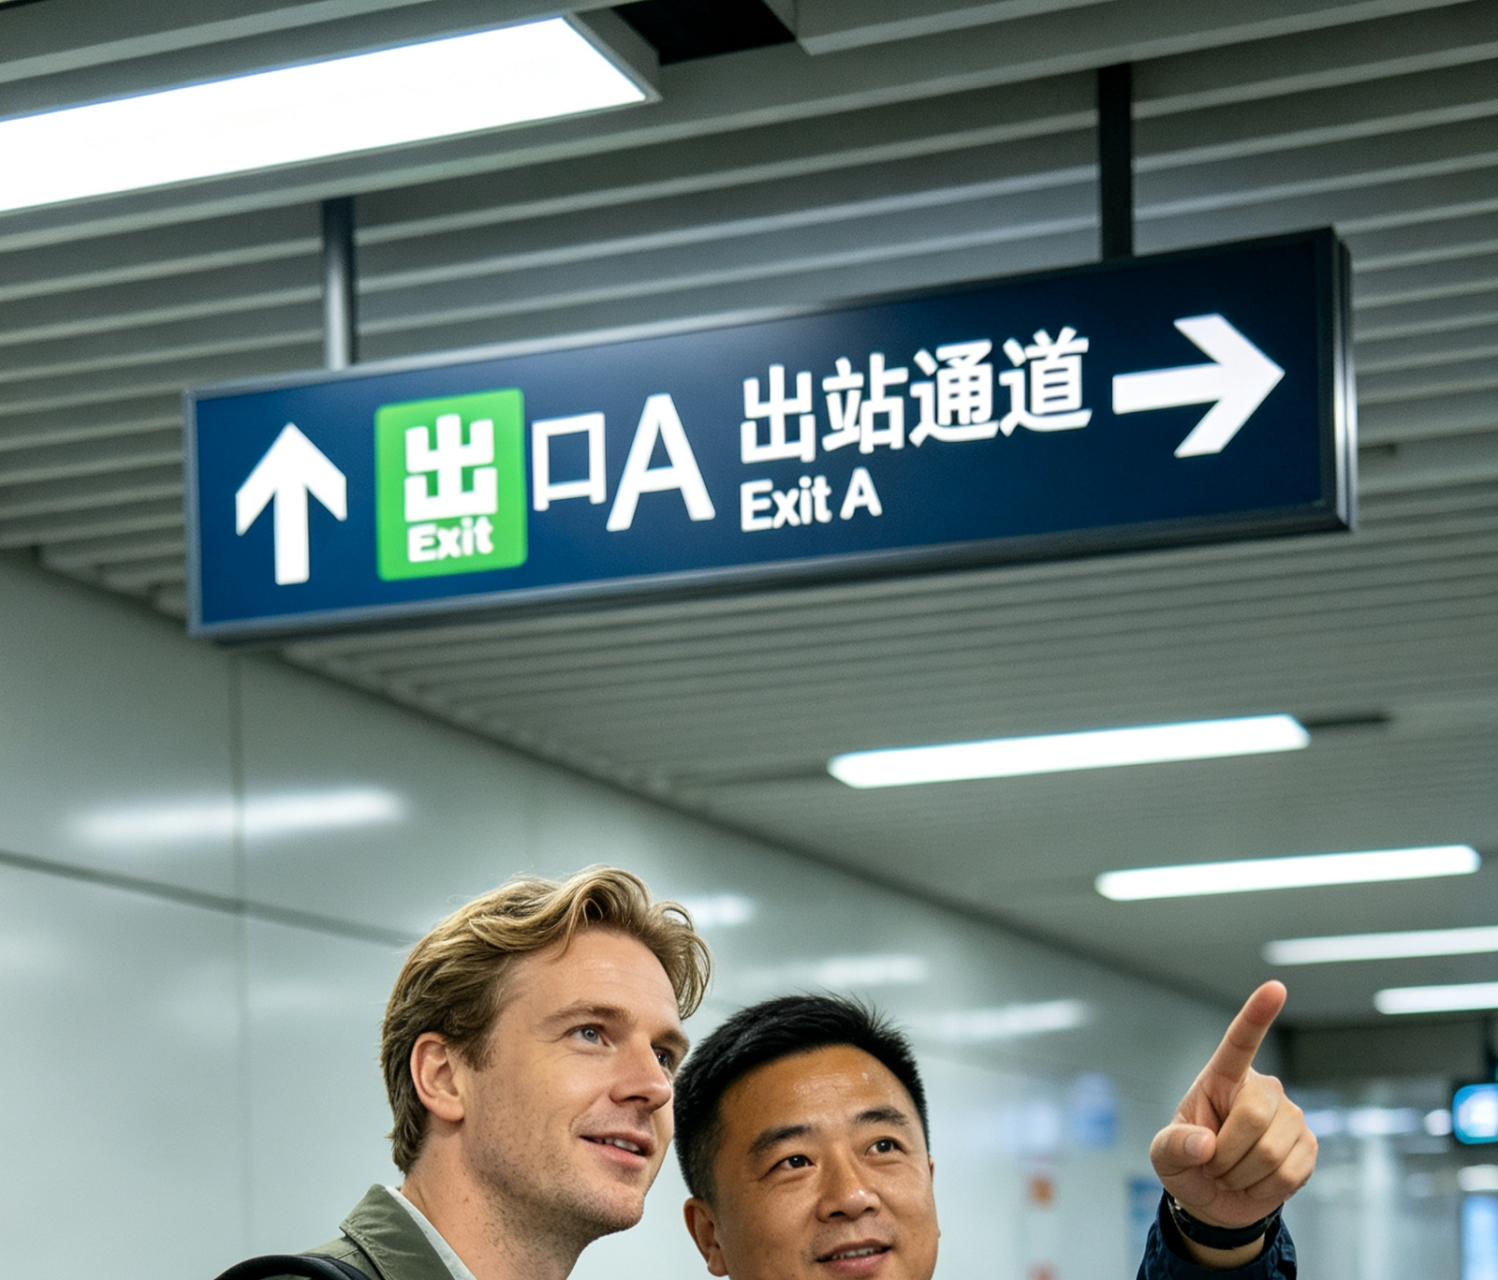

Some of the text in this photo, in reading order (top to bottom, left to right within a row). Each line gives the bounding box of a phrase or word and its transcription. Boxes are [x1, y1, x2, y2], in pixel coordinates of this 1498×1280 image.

[740, 327, 1093, 464] 出站通道
[740, 468, 882, 532] Exit A
[407, 516, 495, 563] Exit
